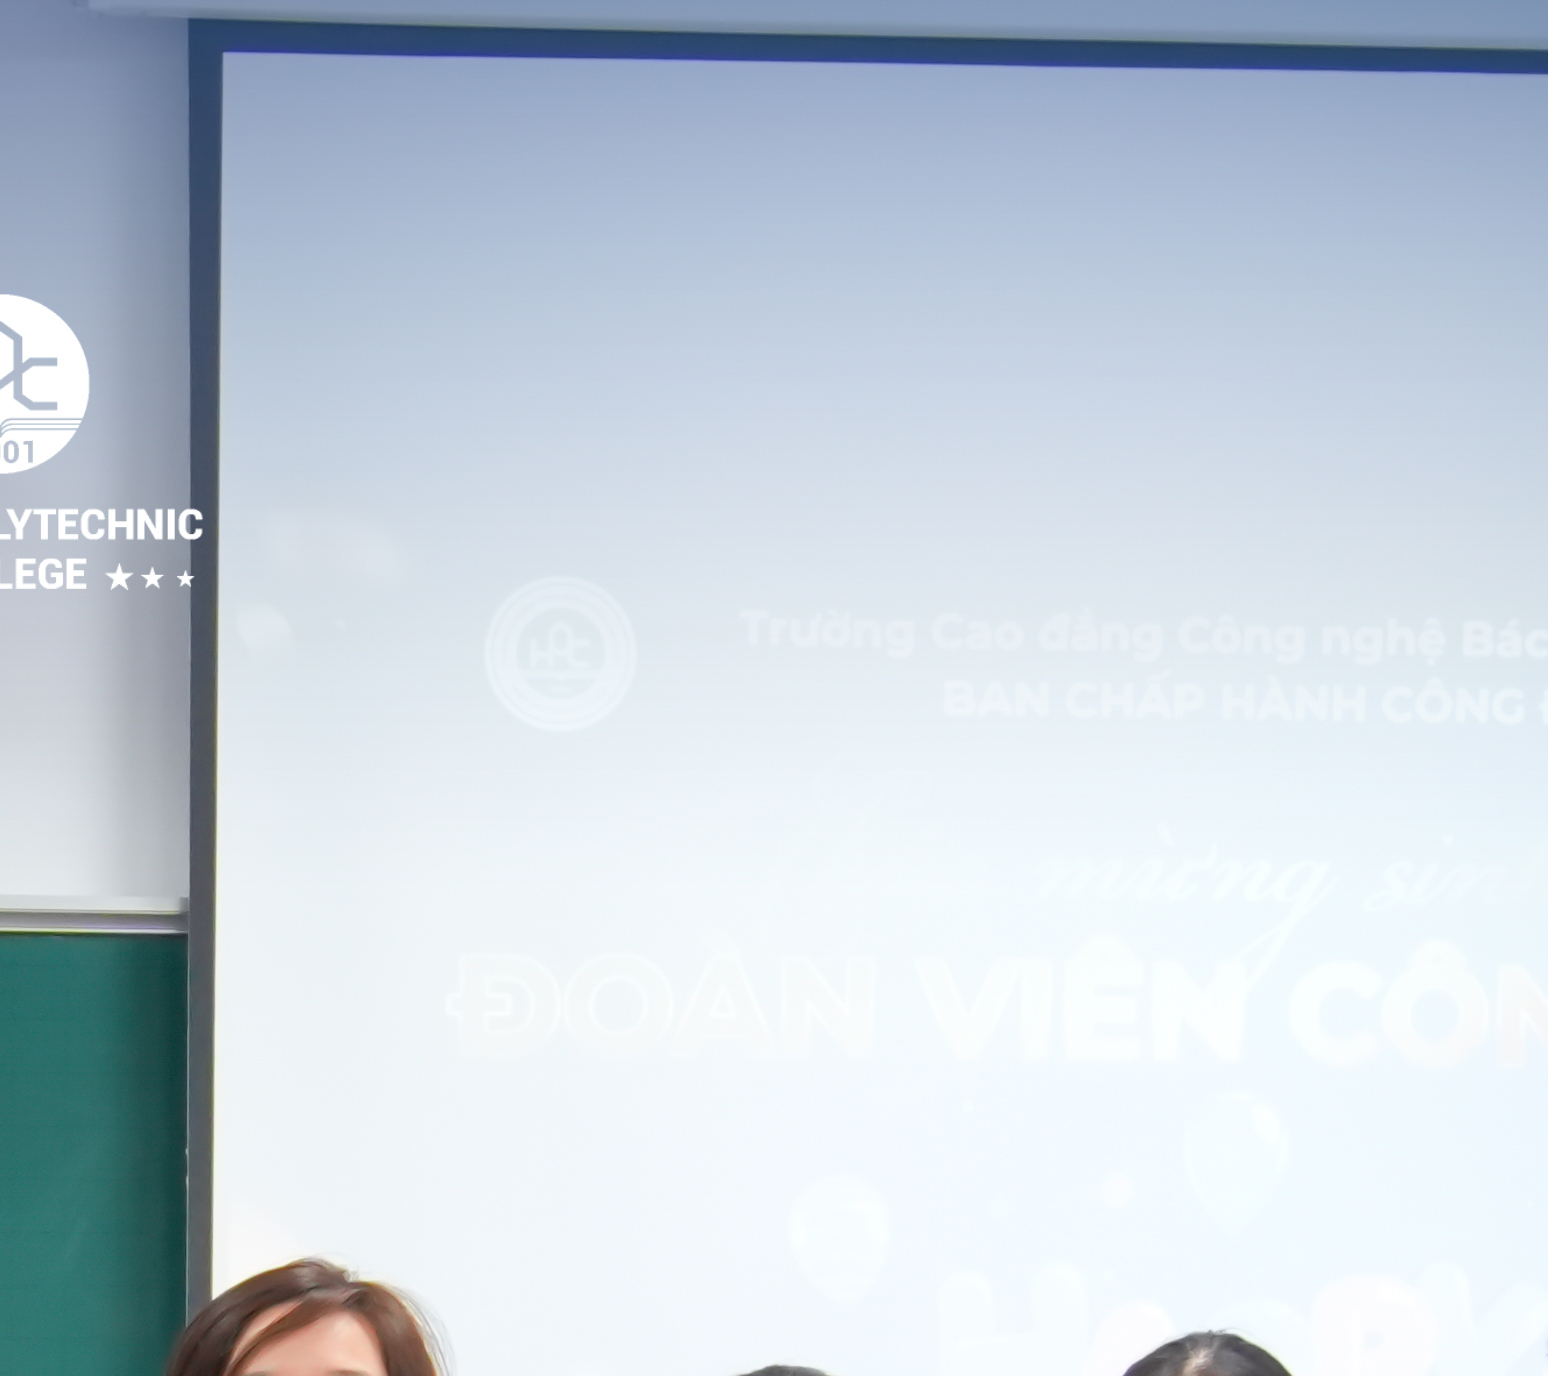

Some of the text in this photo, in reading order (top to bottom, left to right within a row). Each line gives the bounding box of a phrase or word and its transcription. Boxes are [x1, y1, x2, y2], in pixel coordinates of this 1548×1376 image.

[740, 607, 915, 661] Trường
[930, 611, 1024, 657] Cao
[1038, 607, 1165, 666] đẳng
[1179, 609, 1309, 668] Công
[1320, 612, 1447, 668] nghệ
[943, 679, 1049, 720] BAN
[1065, 667, 1206, 723] CHẤP
[1220, 672, 1367, 724] HÀNH
[1382, 676, 1526, 727] CÔNG
[445, 925, 877, 1062] ĐOÀN
[915, 933, 1248, 1066] VIÊN
